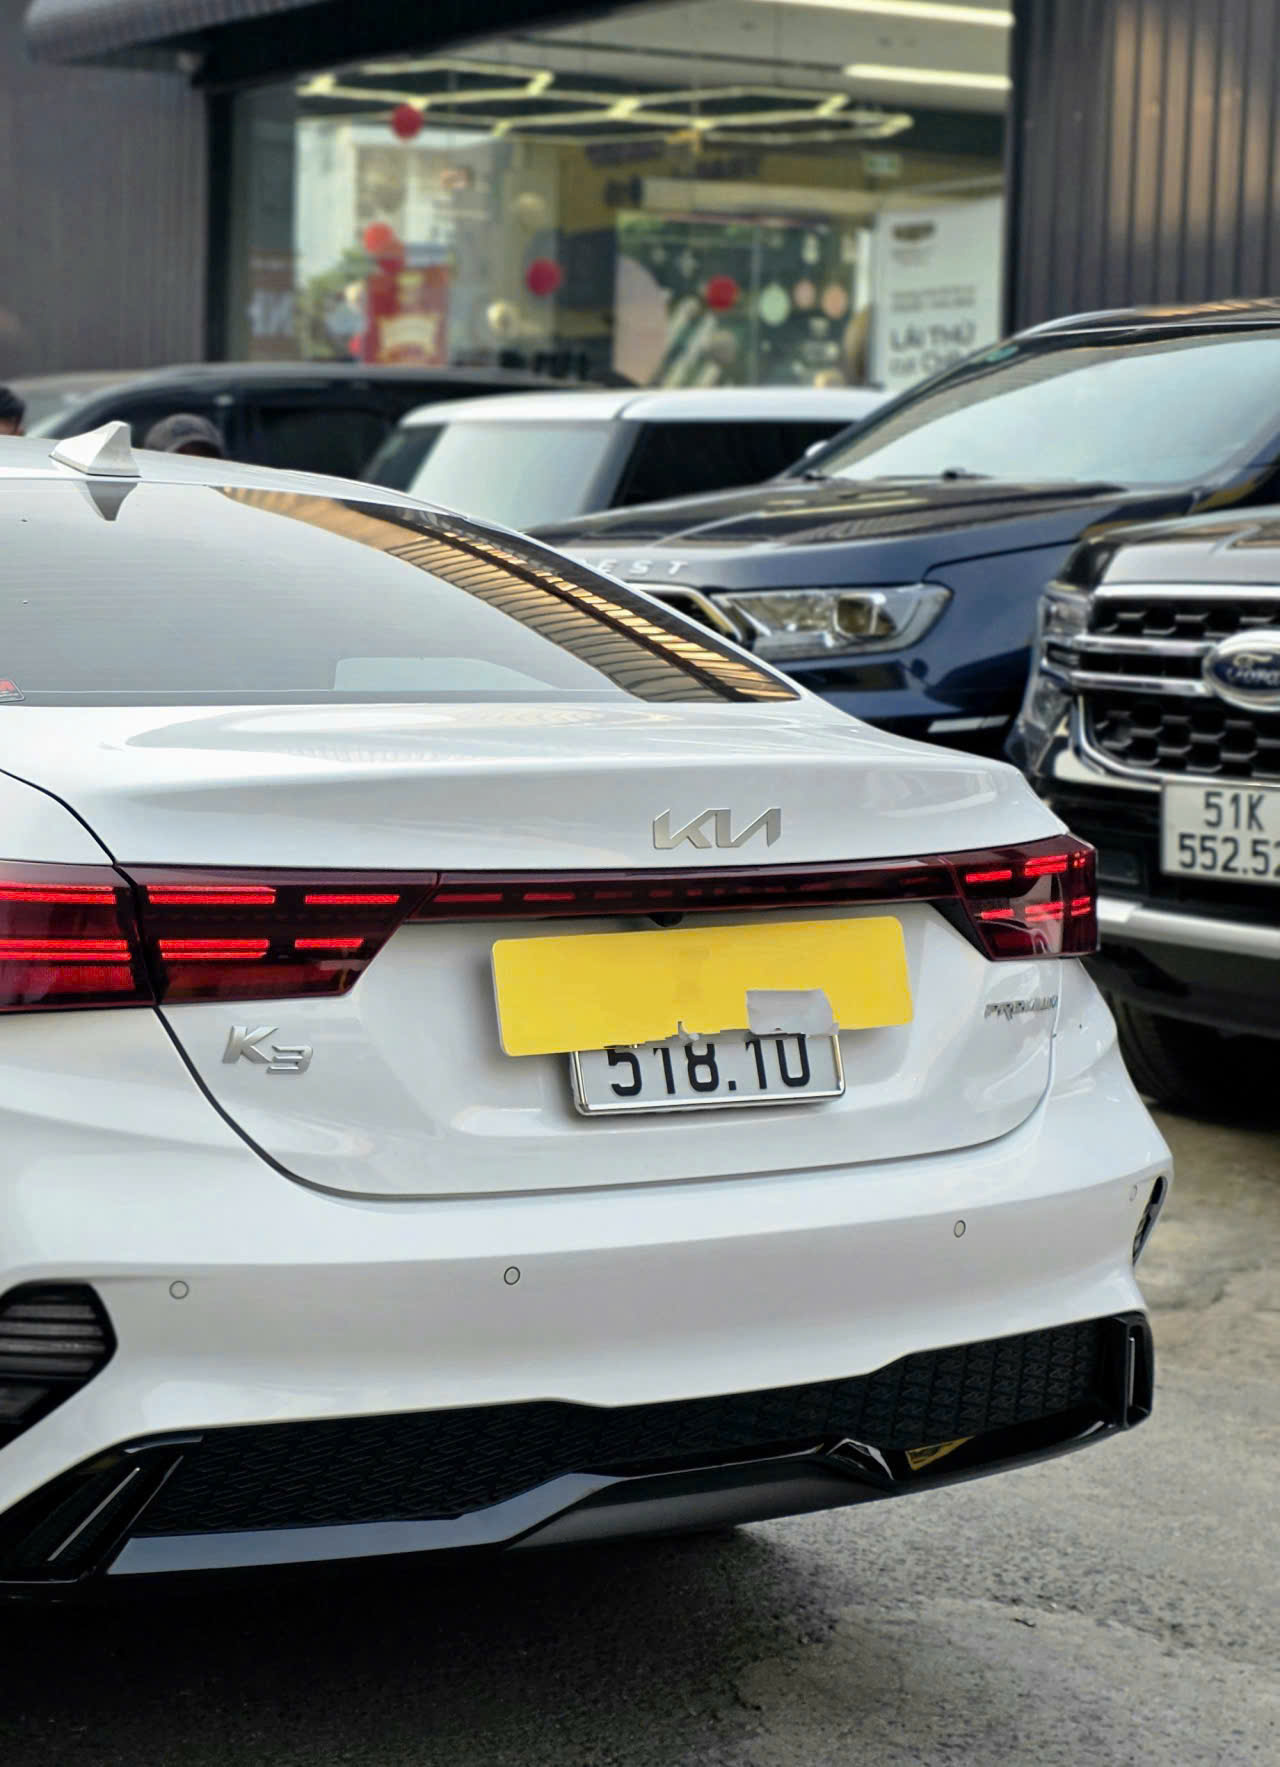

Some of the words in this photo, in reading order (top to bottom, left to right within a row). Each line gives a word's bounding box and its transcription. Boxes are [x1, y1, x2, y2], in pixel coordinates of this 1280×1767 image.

[594, 560, 689, 576] EST
[653, 808, 781, 849] KIA
[1204, 791, 1265, 832] 51K
[222, 1026, 313, 1075] K3
